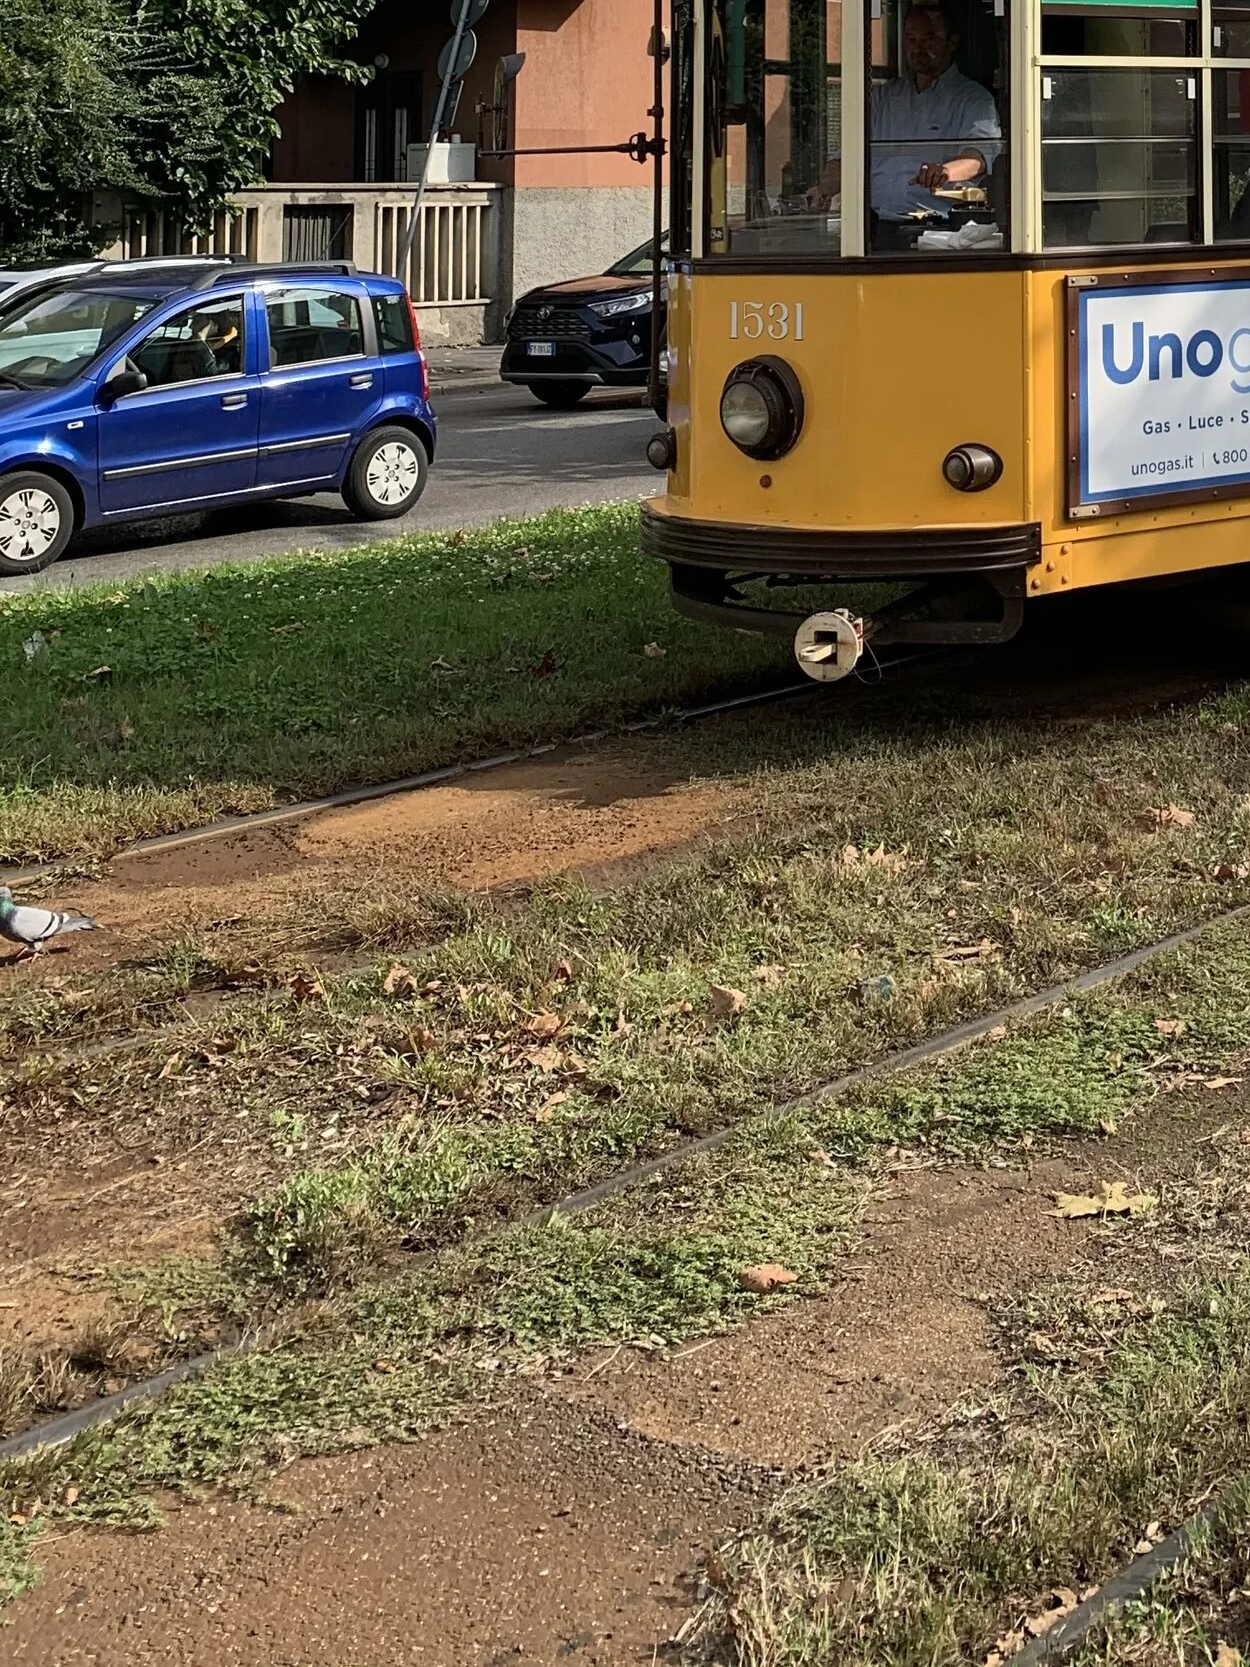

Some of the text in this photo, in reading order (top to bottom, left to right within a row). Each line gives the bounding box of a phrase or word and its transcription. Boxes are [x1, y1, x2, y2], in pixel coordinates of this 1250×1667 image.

[728, 301, 805, 341] 1531
[1143, 419, 1171, 435] Gas
[1188, 414, 1224, 430] Luce
[1131, 454, 1194, 476] unogas.it
[1222, 449, 1248, 464] 800
